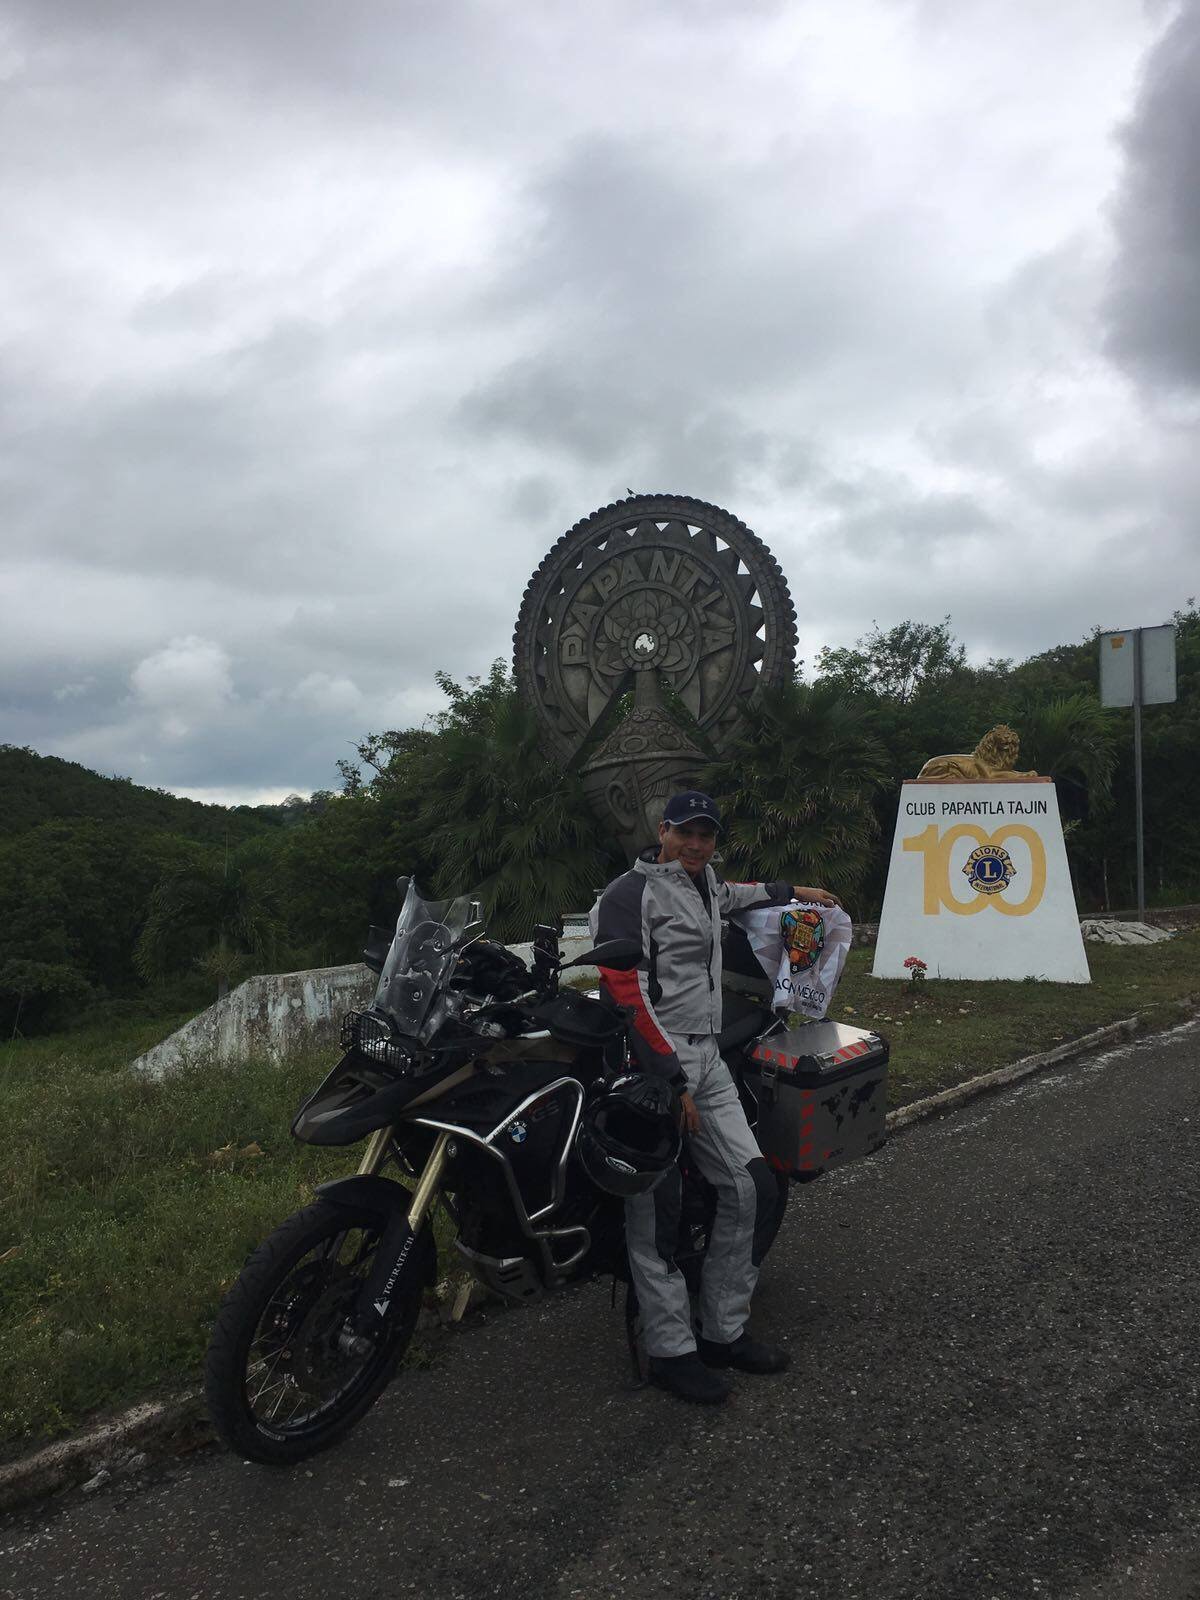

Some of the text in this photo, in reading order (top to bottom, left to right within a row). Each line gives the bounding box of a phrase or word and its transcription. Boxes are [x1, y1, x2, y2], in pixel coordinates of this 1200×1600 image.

[560, 550, 736, 666] PAPANTLA
[905, 800, 1047, 815] CLUB PAPANTLA TAJIN
[902, 823, 1046, 916] 100
[974, 847, 1006, 859] LIONS
[983, 861, 997, 878] L
[382, 1234, 416, 1295] TOURATECH
